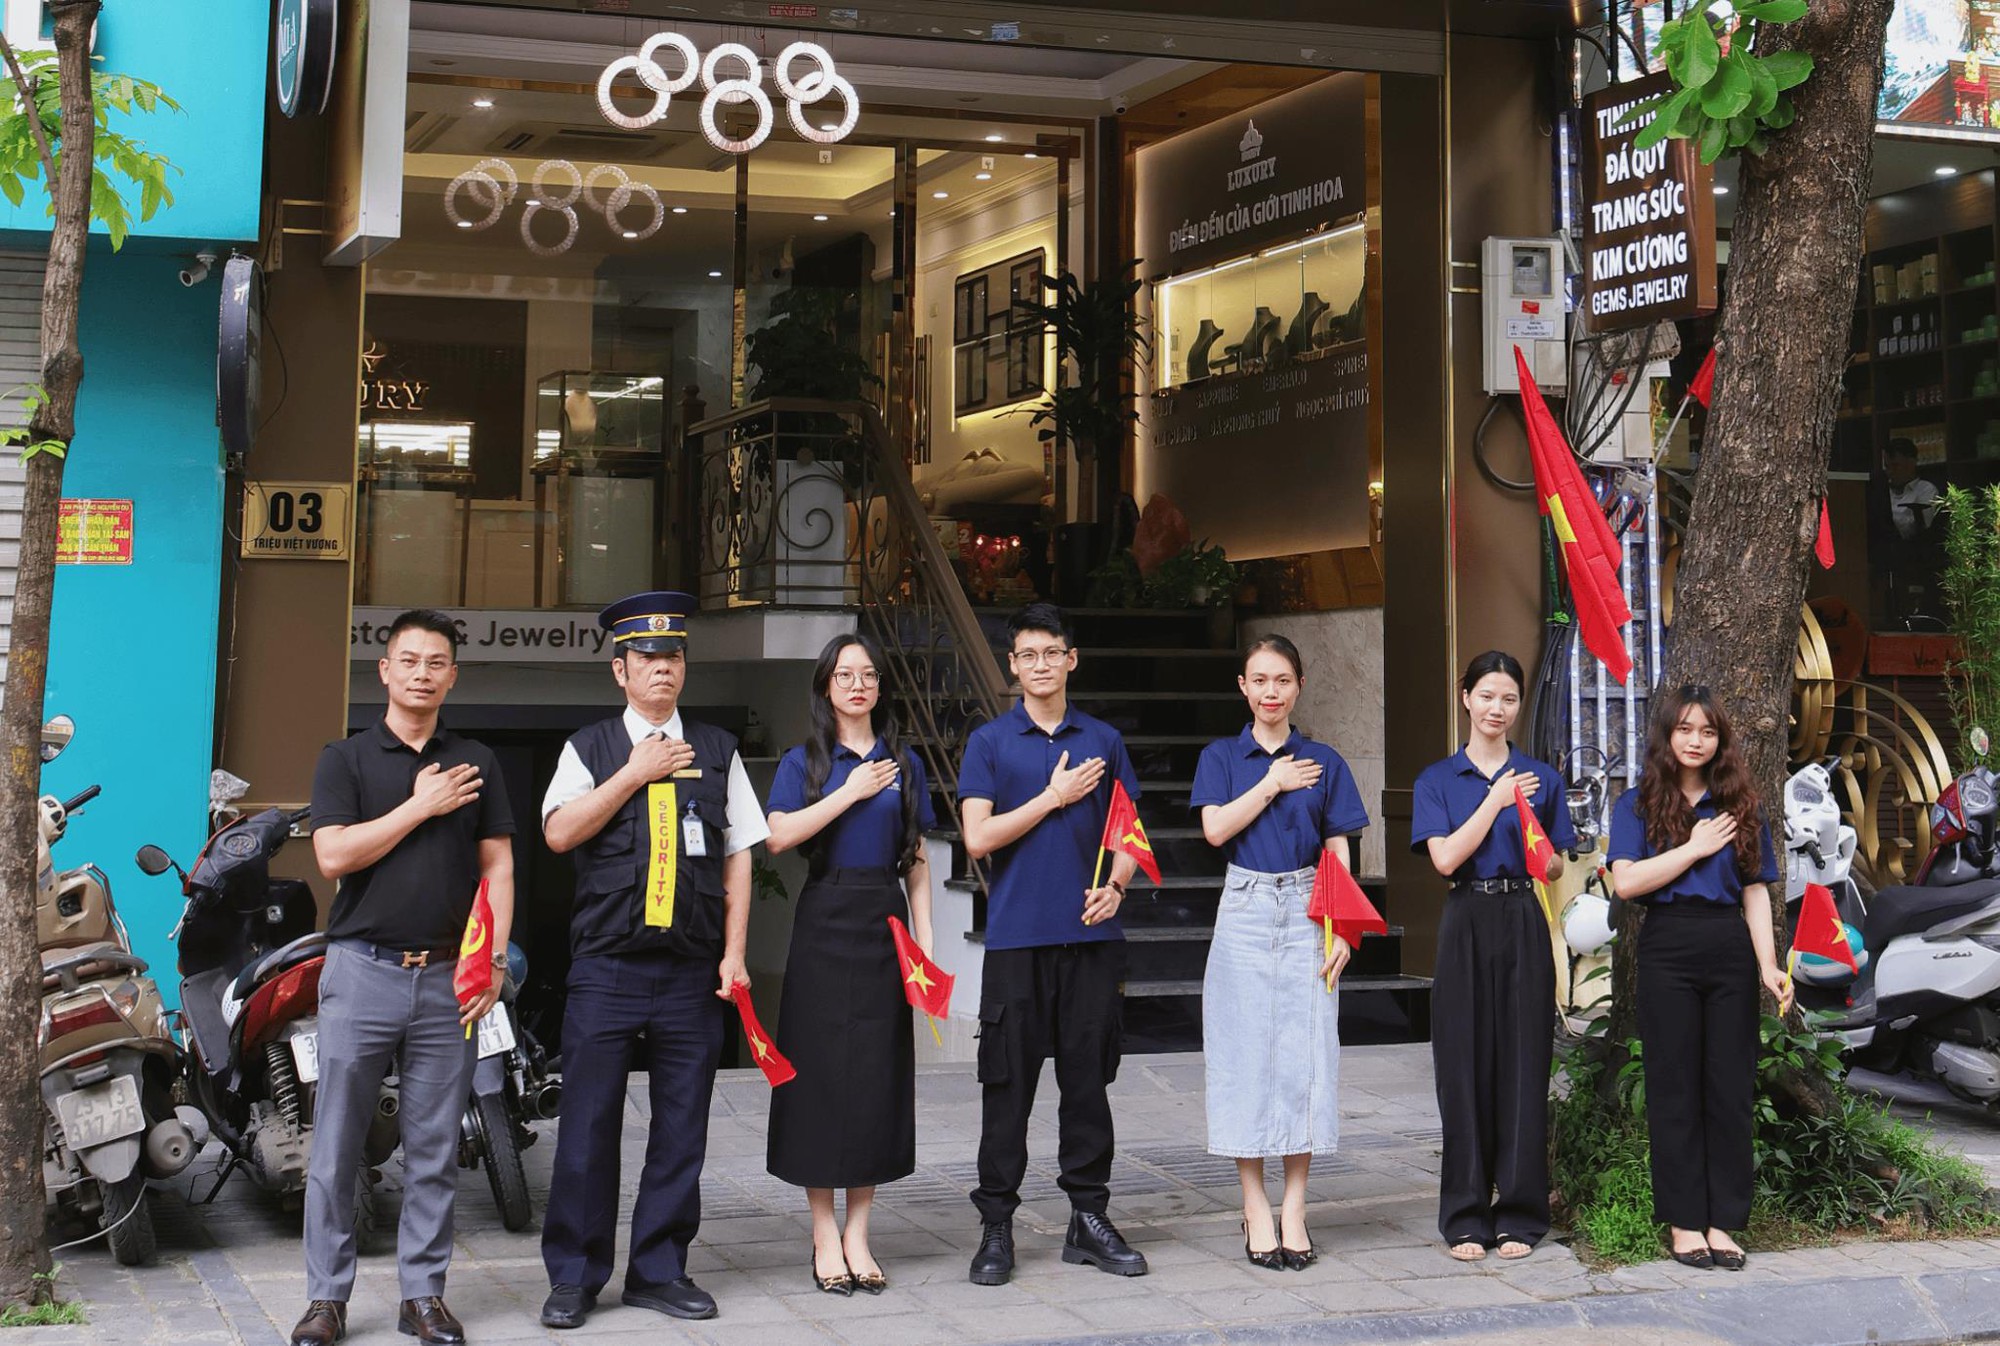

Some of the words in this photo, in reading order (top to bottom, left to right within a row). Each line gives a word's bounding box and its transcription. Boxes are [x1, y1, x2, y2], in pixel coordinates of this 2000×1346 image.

[1226, 156, 1277, 192] LUXURY
[1604, 141, 1631, 185] ĐÁ
[1199, 211, 1225, 243] ĐẾN
[1225, 202, 1251, 235] CỦA
[1252, 193, 1280, 226] GIỚI
[1280, 185, 1312, 217] TINH
[1313, 176, 1344, 207] HOA
[1591, 192, 1648, 234] TRANG
[1650, 178, 1685, 221] SỨC
[1592, 246, 1624, 282] KIM
[1625, 231, 1688, 274] CƯƠNG
[1591, 286, 1627, 316] GEMS
[1628, 274, 1689, 309] JEWELRY
[269, 491, 322, 533] 03
[254, 536, 281, 551] TRIỆU
[283, 536, 303, 552] VIỆT
[305, 538, 338, 551] VƯƠNG
[478, 620, 608, 654] Jewelry
[656, 800, 670, 907] SECURITY
